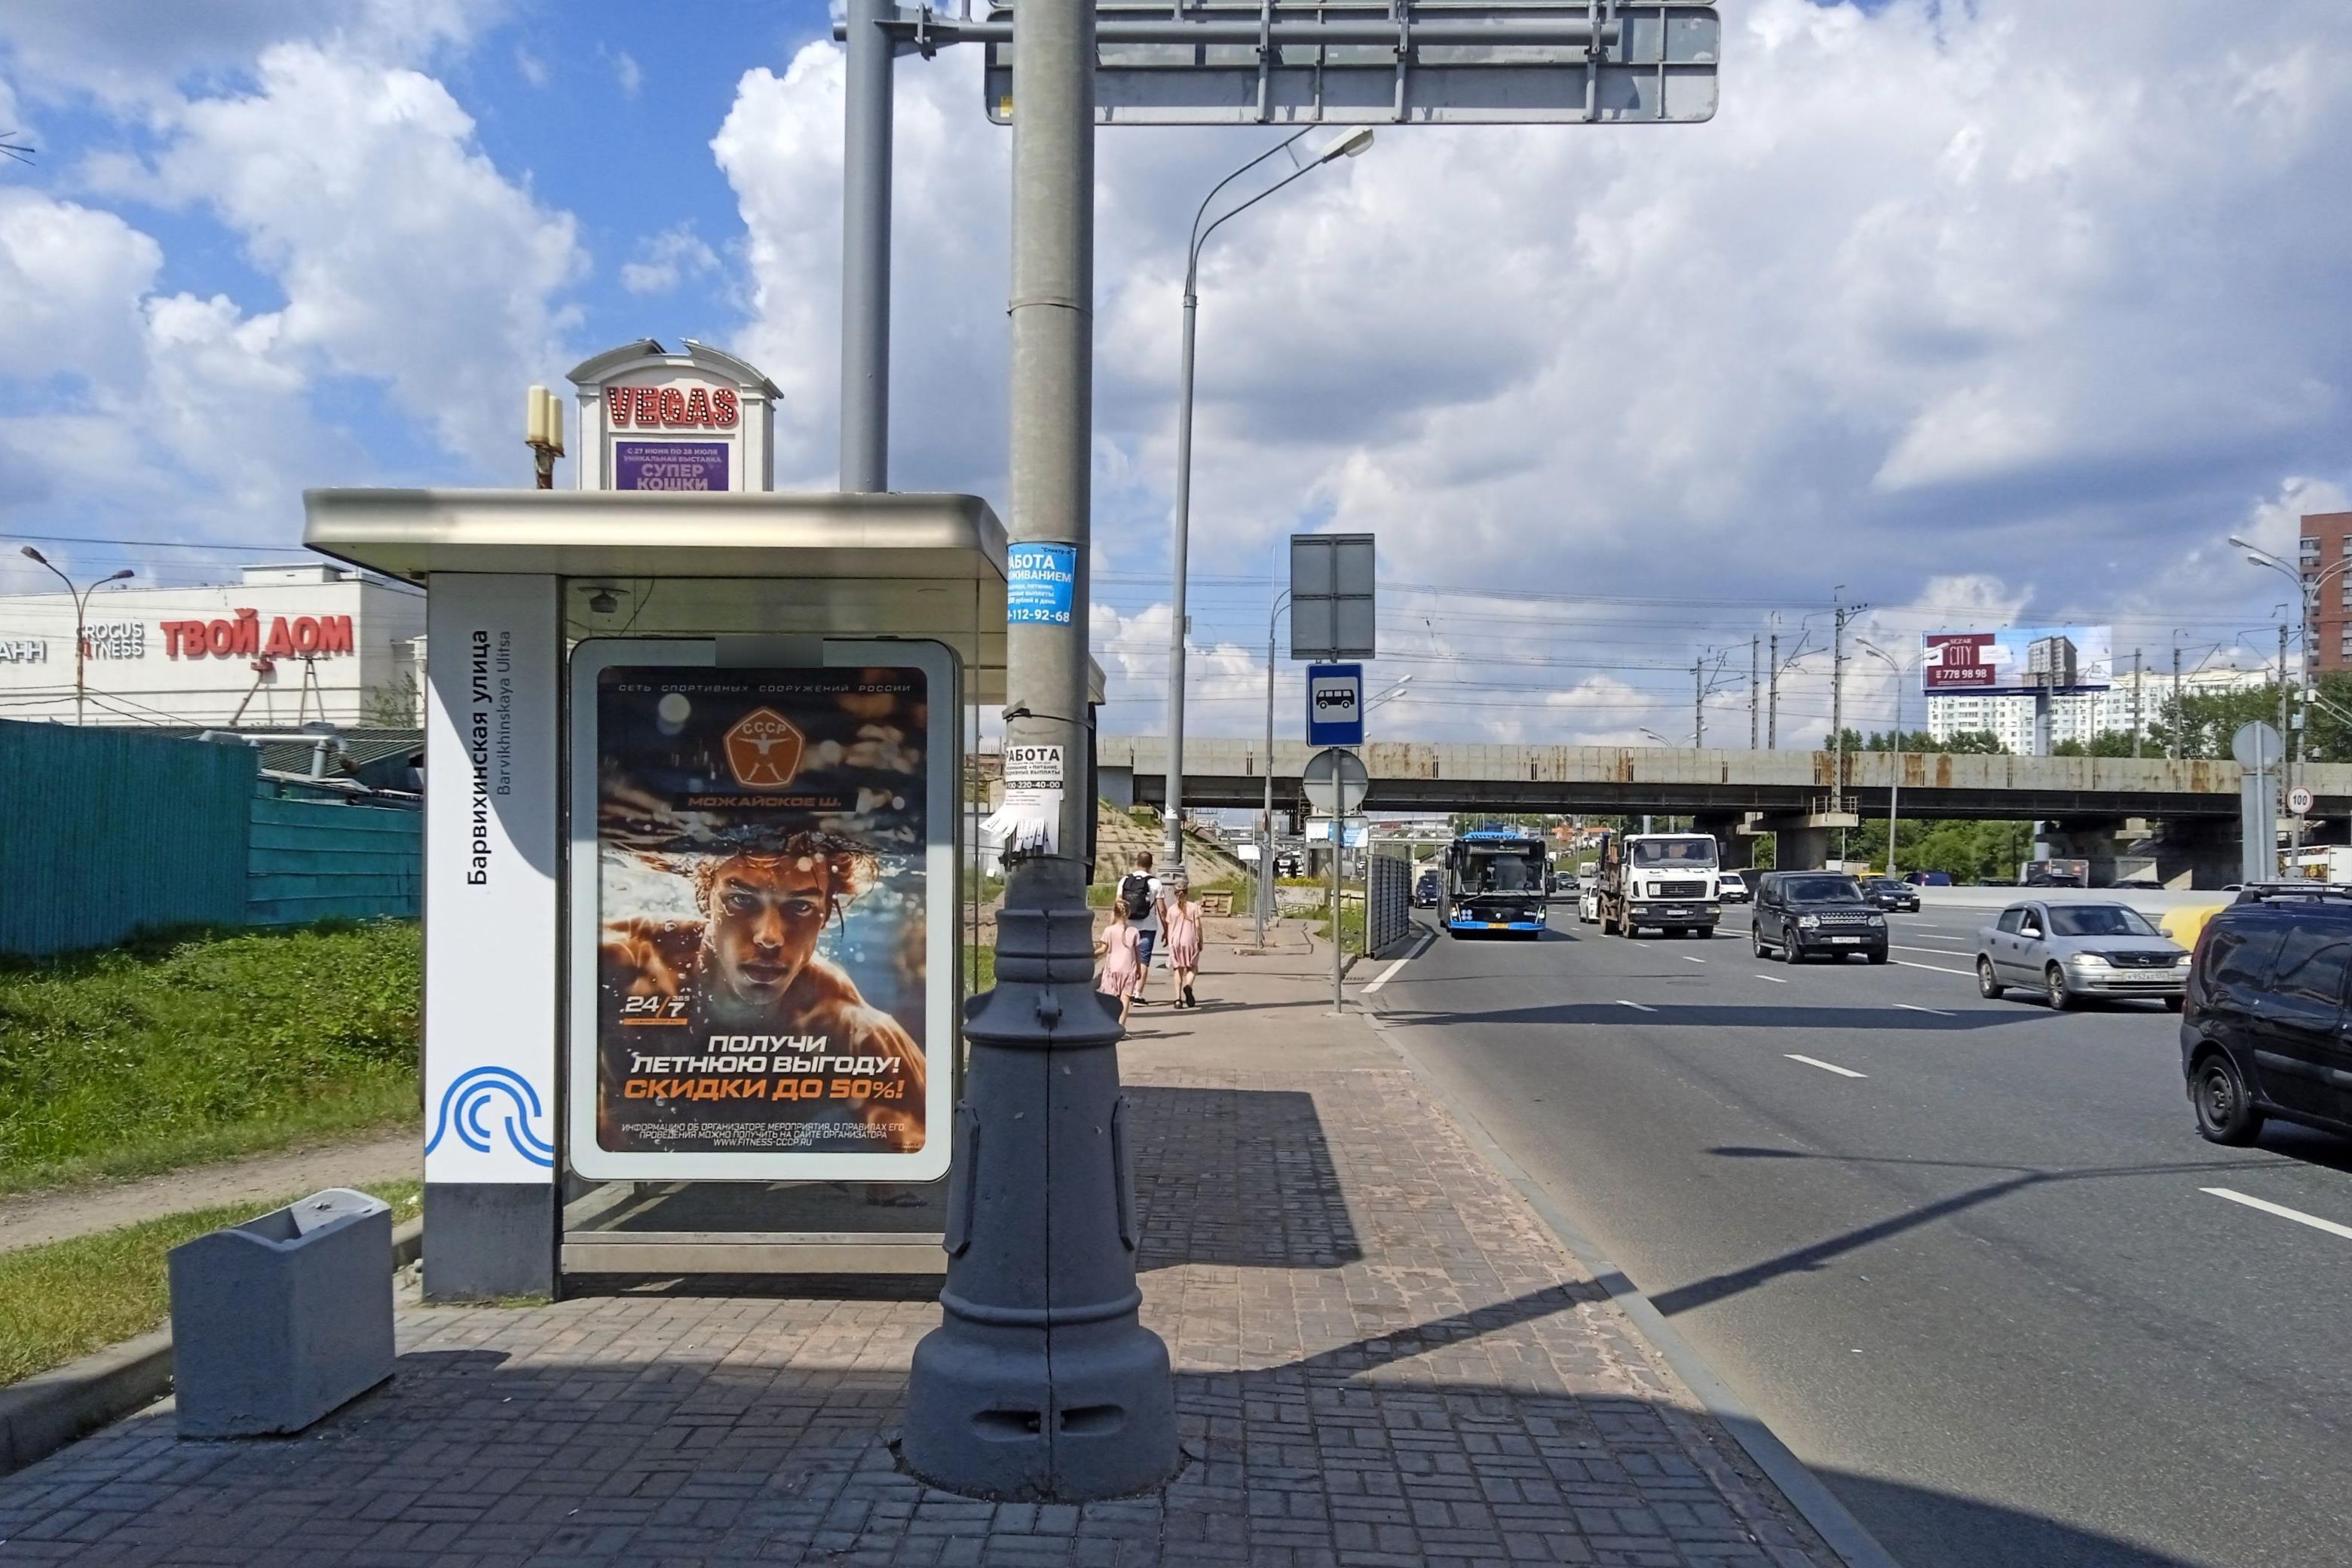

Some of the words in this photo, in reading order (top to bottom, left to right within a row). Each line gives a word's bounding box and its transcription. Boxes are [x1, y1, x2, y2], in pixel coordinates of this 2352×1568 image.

[606, 387, 739, 426] VEGAS
[642, 464, 704, 476] СУПЕР
[637, 478, 709, 490] КОШКИ
[1009, 554, 1055, 569] АБОТА
[161, 608, 259, 657] ТВОЙ
[265, 615, 354, 657] ДОМ
[496, 631, 511, 672] Ulitsa
[1949, 646, 1972, 666] CITY
[472, 630, 492, 703] улица
[1943, 669, 1960, 678] 778
[1962, 669, 1974, 678] 98
[1975, 669, 1987, 678] 98
[758, 684, 849, 692] СООРУЖЕНИЙ
[743, 721, 786, 734] СССР
[496, 678, 513, 796] Barvikhinskaya
[467, 712, 492, 885] Барвихинская
[688, 795, 816, 807] МОЖАЙСКОЕ
[2293, 795, 2308, 805] 100
[625, 996, 685, 1018] 24/7
[708, 1035, 828, 1052] ПОЛУЧИ
[630, 1055, 768, 1073] ЛЕТНЮЮ
[772, 1056, 902, 1076] ВЫГОДУ!
[623, 1079, 768, 1101] СКИДКИ
[772, 1079, 824, 1101] ДО
[829, 1079, 905, 1099] 50%!
[622, 1123, 685, 1132] ИНФОРМАЦИЮ
[701, 1122, 766, 1131] ОРГАНИЗАТОРЕ
[639, 1131, 696, 1139] ПРОВЕДЕНИЯ
[713, 1138, 812, 1147] WWW.FITNESS-CCCP.RU
